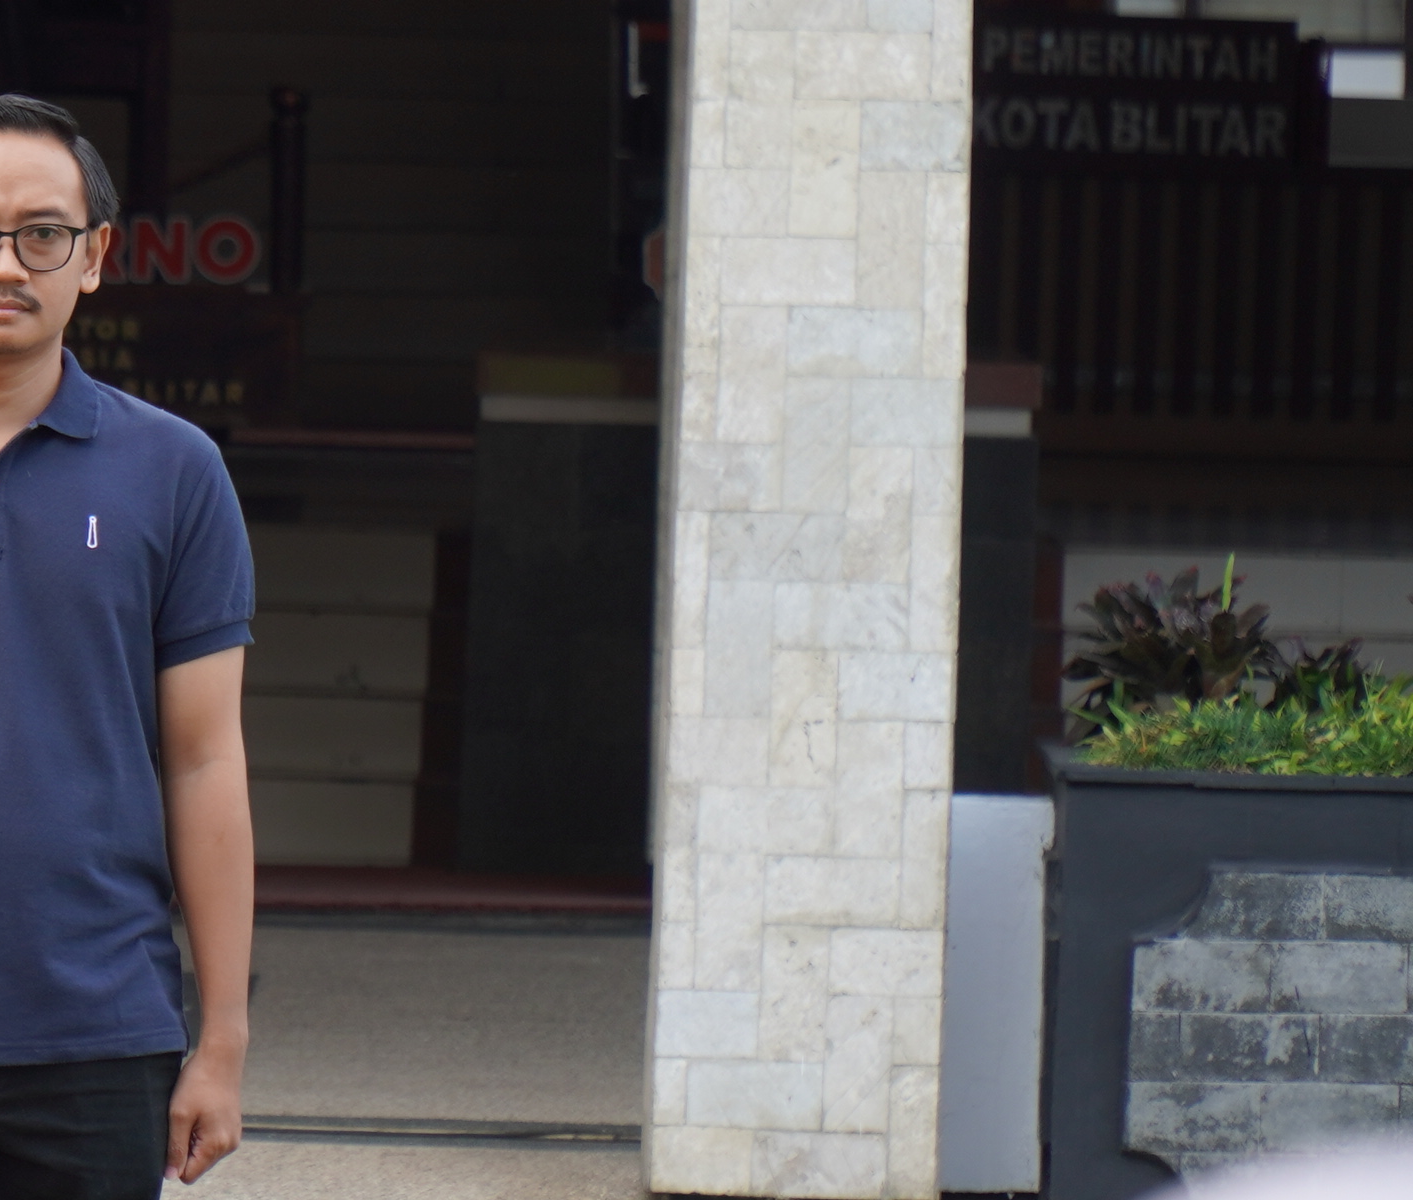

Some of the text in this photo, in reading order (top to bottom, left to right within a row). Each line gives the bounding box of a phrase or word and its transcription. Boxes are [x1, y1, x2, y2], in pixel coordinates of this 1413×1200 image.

[982, 25, 1279, 83] PEMERINTAH
[974, 95, 1289, 160] KOTA BLITAR
